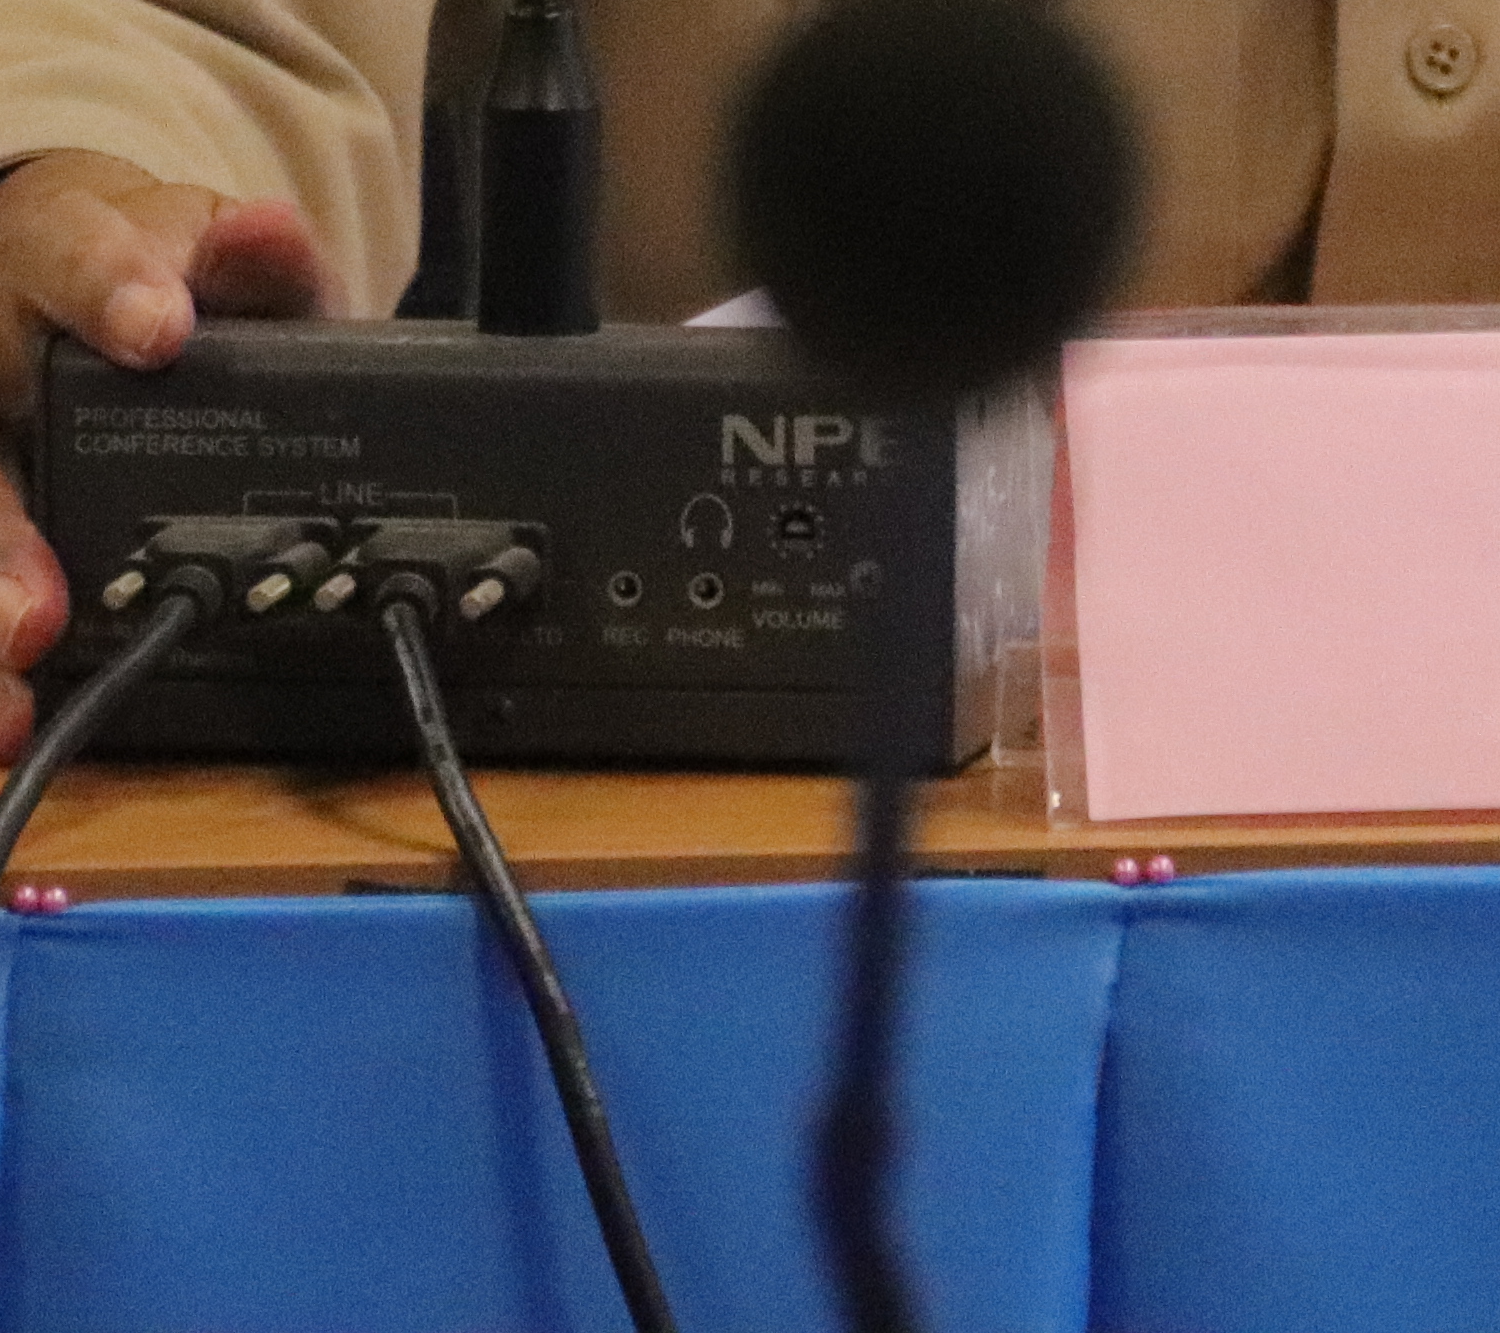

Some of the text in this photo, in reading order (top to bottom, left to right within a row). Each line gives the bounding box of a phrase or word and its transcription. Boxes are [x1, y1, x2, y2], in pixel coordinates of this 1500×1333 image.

[73, 406, 268, 430] PROFESSIONAL
[73, 433, 362, 459] CONFERENCE SYSTEM
[720, 468, 868, 488] RESEAR
[318, 481, 386, 506] LINE
[750, 609, 845, 631] VOLUME
[601, 624, 649, 647] REC
[665, 626, 745, 650] PHONE
